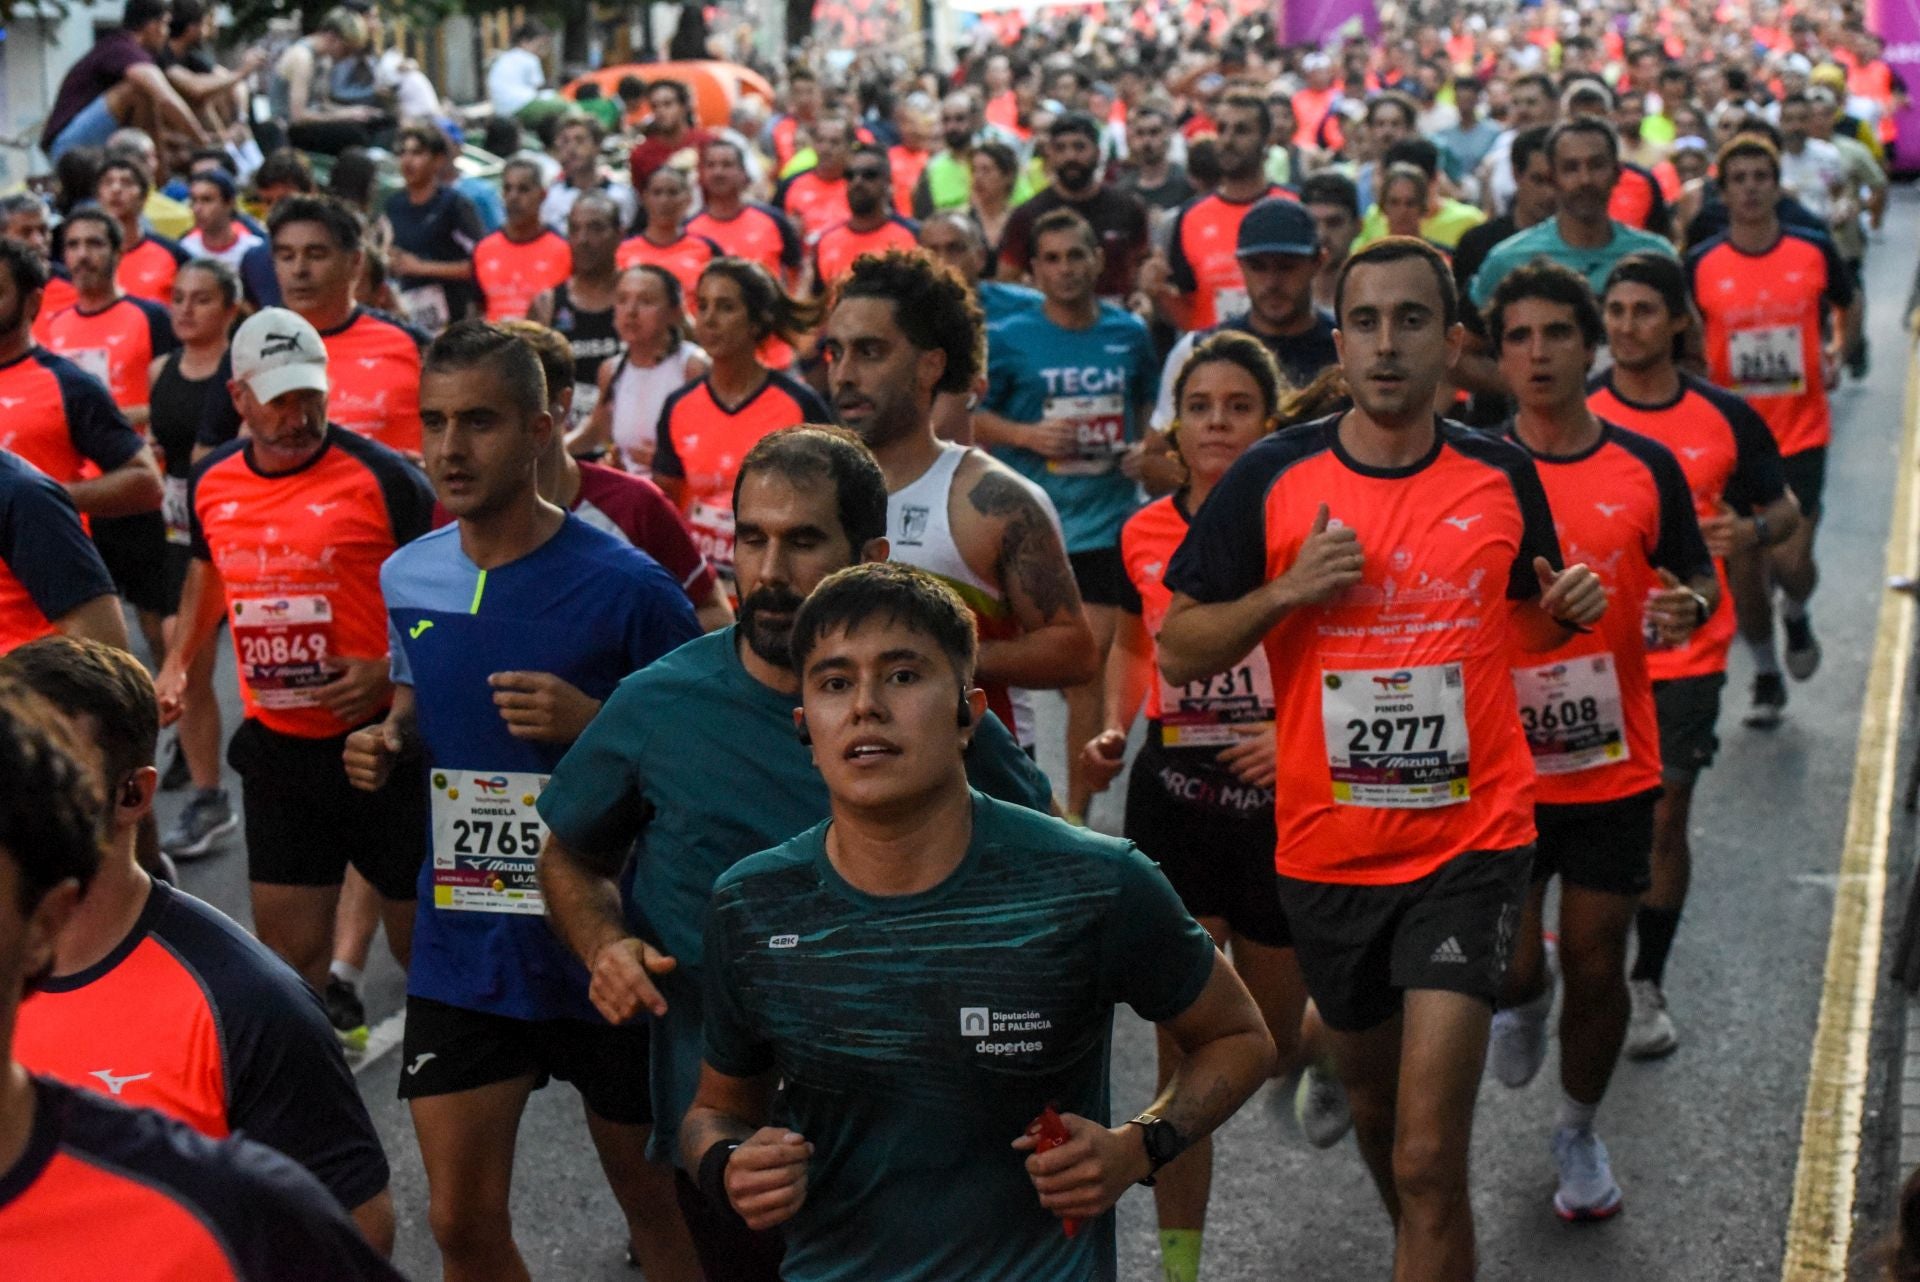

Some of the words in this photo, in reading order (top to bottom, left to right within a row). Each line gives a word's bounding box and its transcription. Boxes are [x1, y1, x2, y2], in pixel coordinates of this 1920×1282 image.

[260, 341, 297, 359] PUMA
[1039, 366, 1126, 396] TECH
[241, 633, 327, 665] 20849
[1374, 703, 1414, 714] PINEDO
[1520, 695, 1598, 731] 3608
[1346, 714, 1446, 752] 2977
[1220, 785, 1275, 811] MAX
[470, 806, 517, 817] NOMBELA
[452, 818, 541, 856] 2765
[992, 1010, 1041, 1022] Diputación
[992, 1022, 1006, 1032] DE
[1007, 1020, 1053, 1032] PALENCIA
[975, 1040, 1044, 1056] deportes
